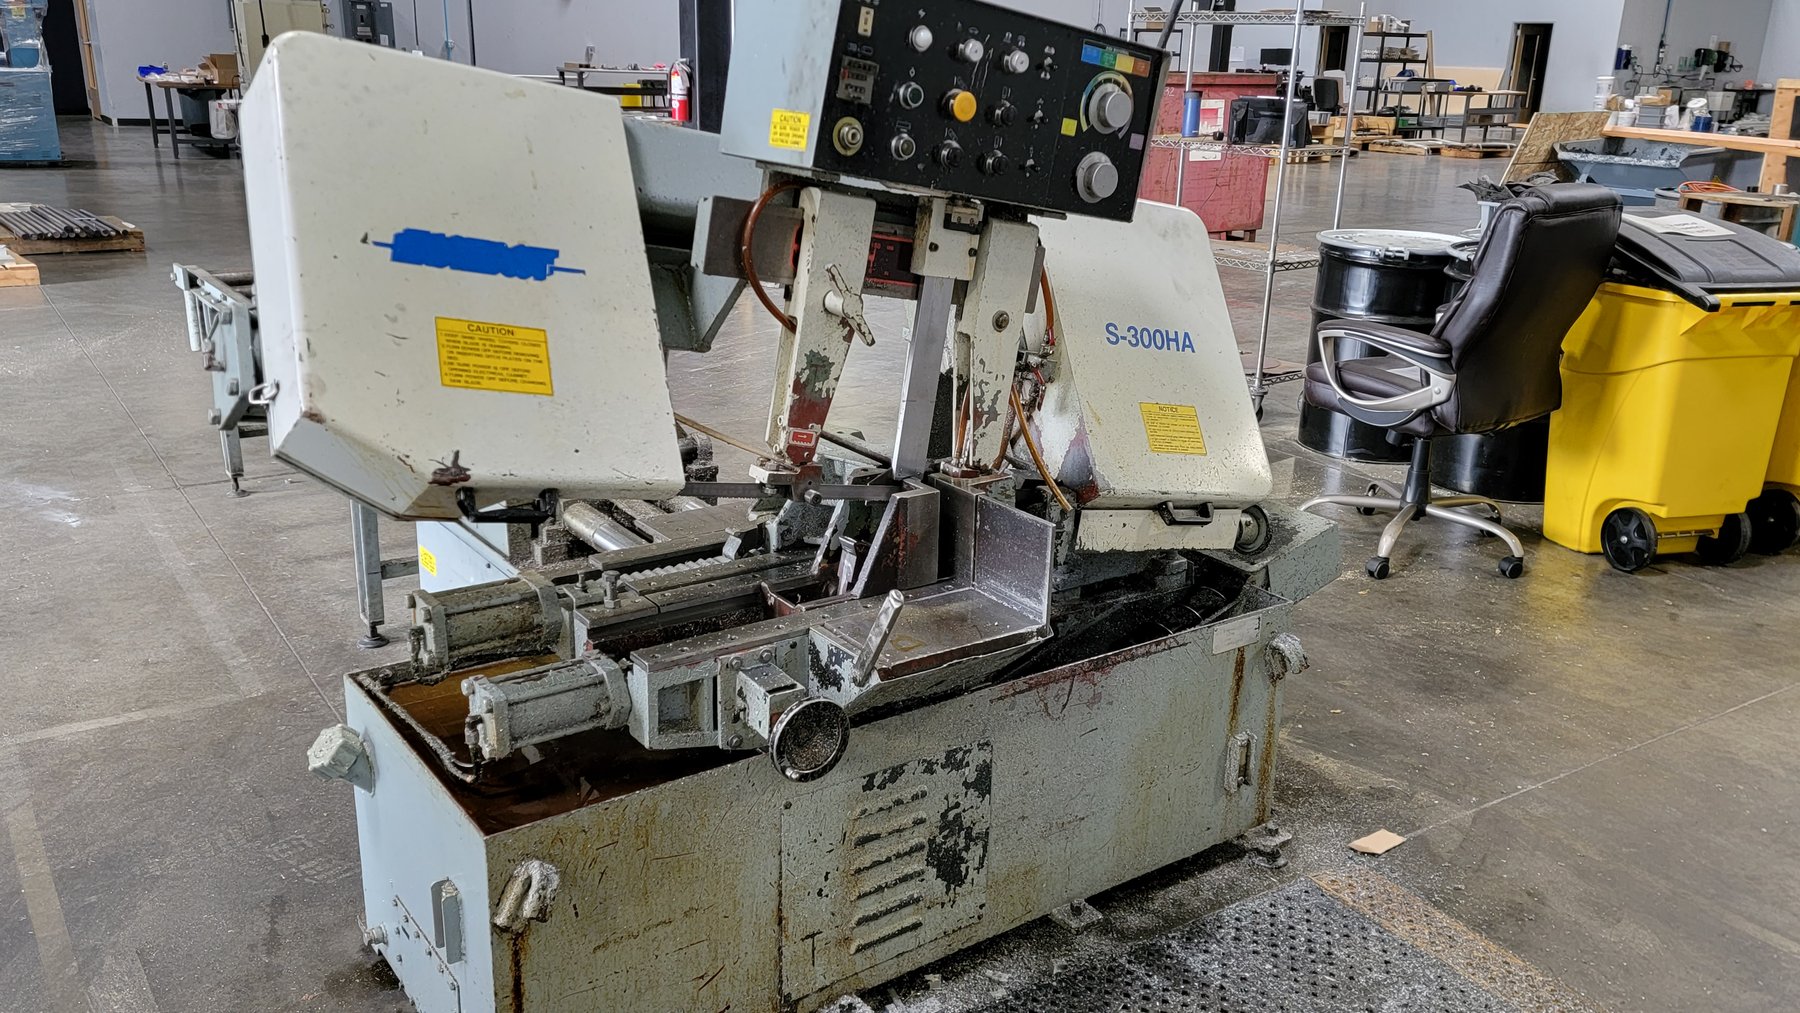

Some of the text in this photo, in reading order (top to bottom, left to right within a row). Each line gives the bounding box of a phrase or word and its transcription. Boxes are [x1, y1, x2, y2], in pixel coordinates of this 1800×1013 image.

[780, 114, 802, 123] CAUTION
[467, 324, 515, 337] CAUTION
[1105, 322, 1196, 354] S-300HA
[1158, 405, 1180, 413] NOTICE
